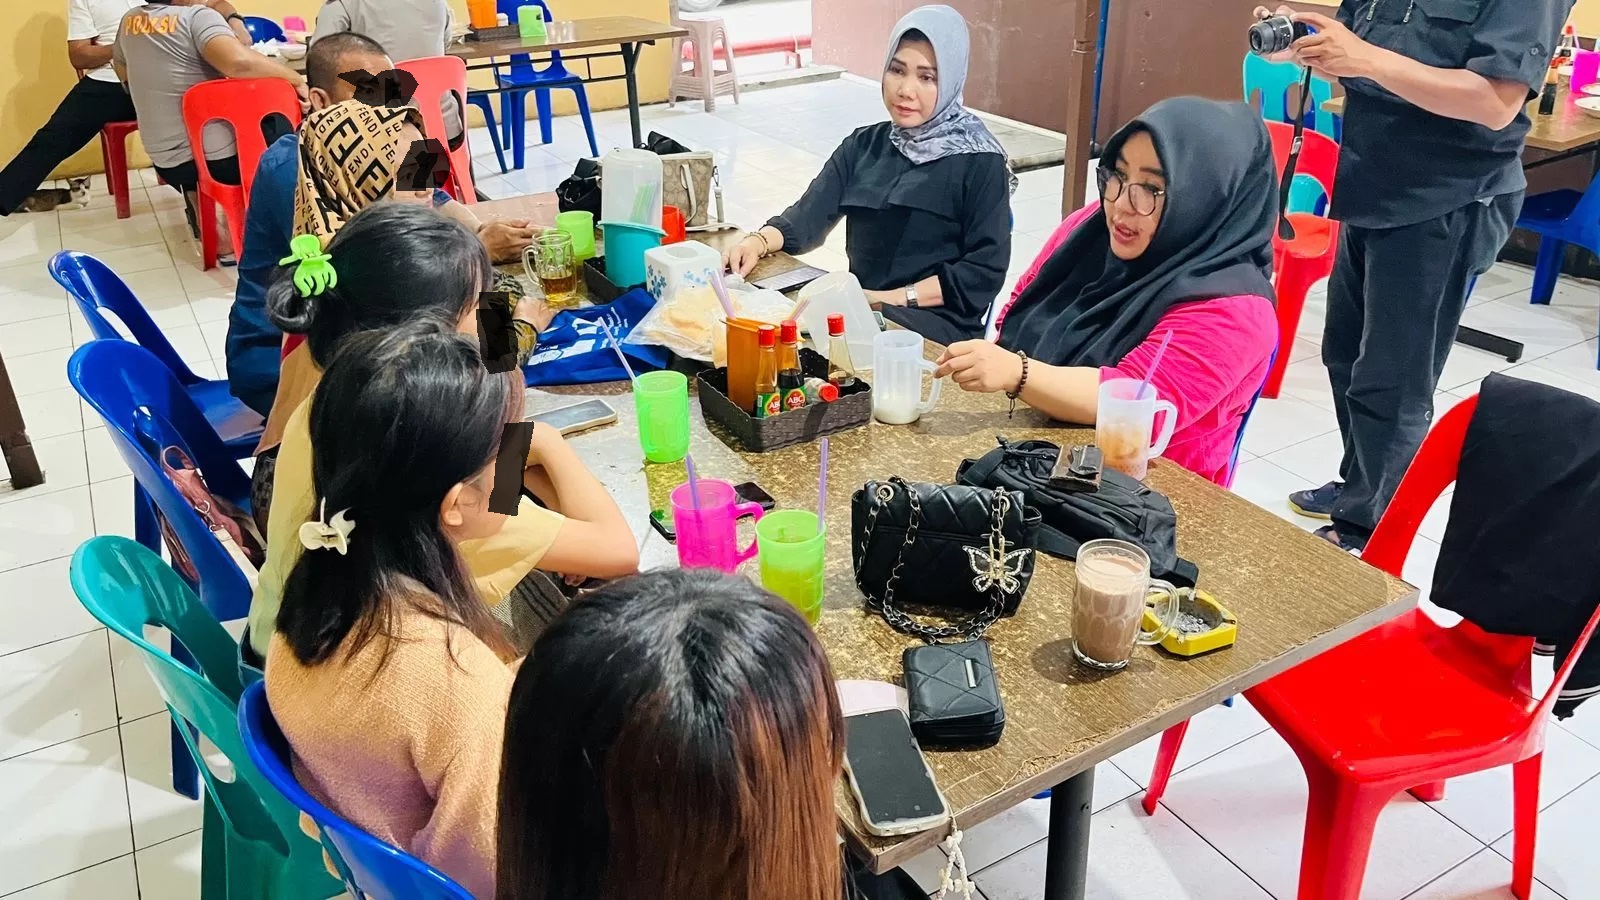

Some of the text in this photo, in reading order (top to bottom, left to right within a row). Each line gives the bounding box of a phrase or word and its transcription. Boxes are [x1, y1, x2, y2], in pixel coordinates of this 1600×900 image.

[315, 107, 349, 139] FENDI
[356, 106, 381, 138] FENDI
[787, 395, 805, 404] ABC
